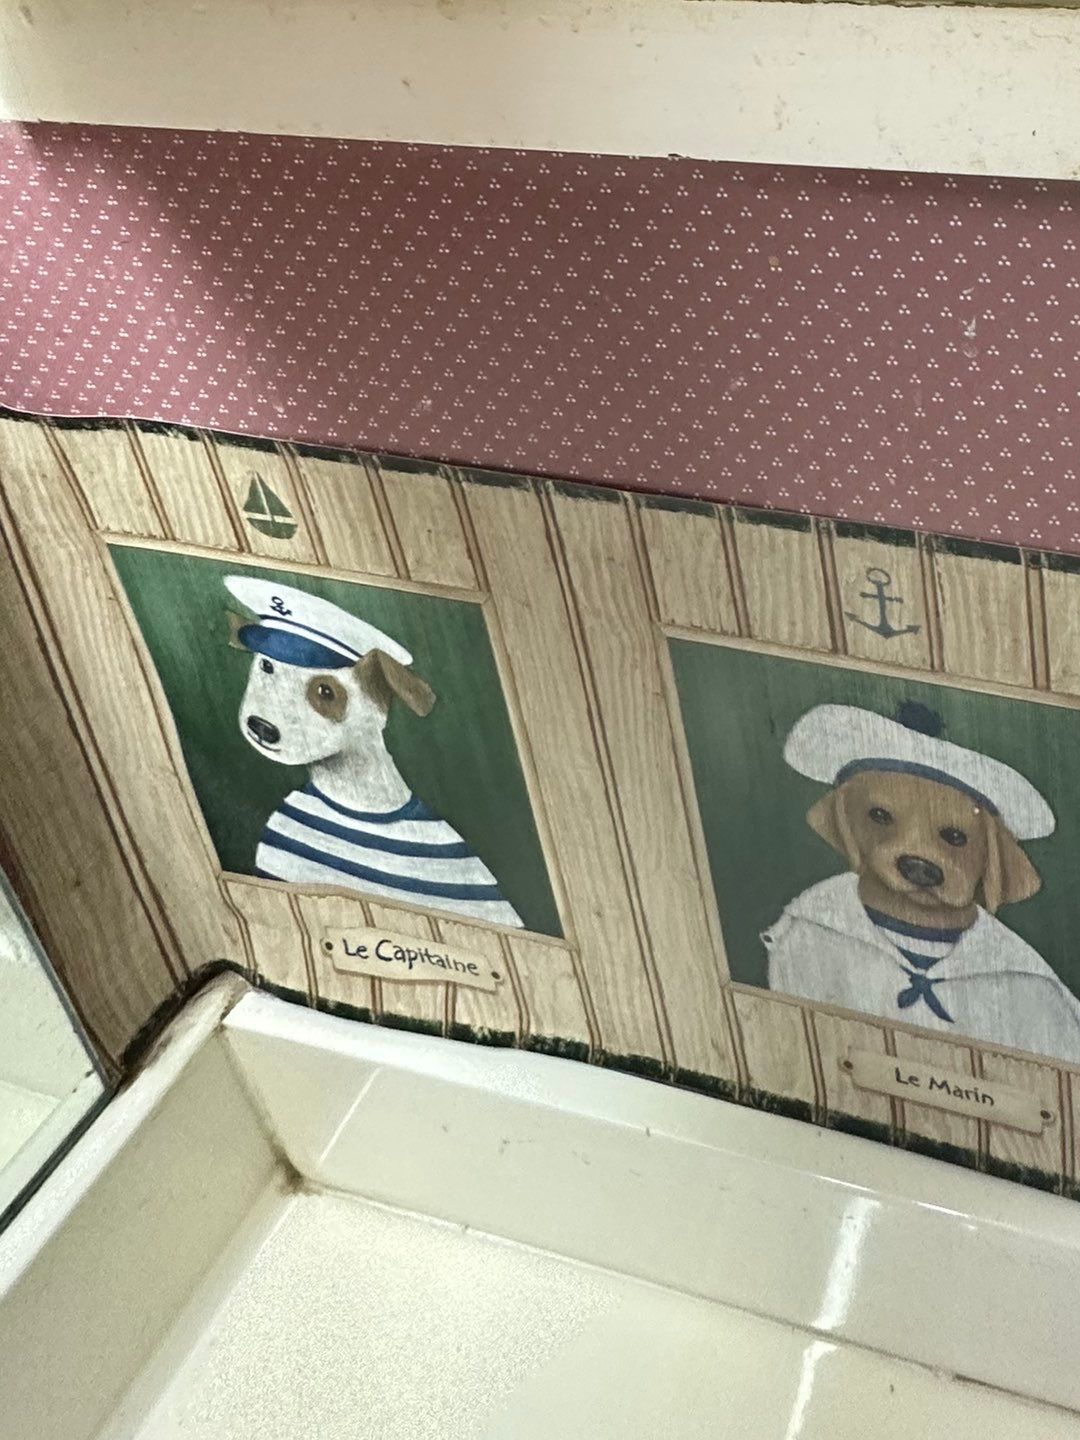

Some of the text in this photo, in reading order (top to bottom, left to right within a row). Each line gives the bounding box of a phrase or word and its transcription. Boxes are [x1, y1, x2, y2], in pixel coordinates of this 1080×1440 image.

[342, 938, 480, 977] Le Capitaine
[895, 1067, 994, 1106] Le Marin
